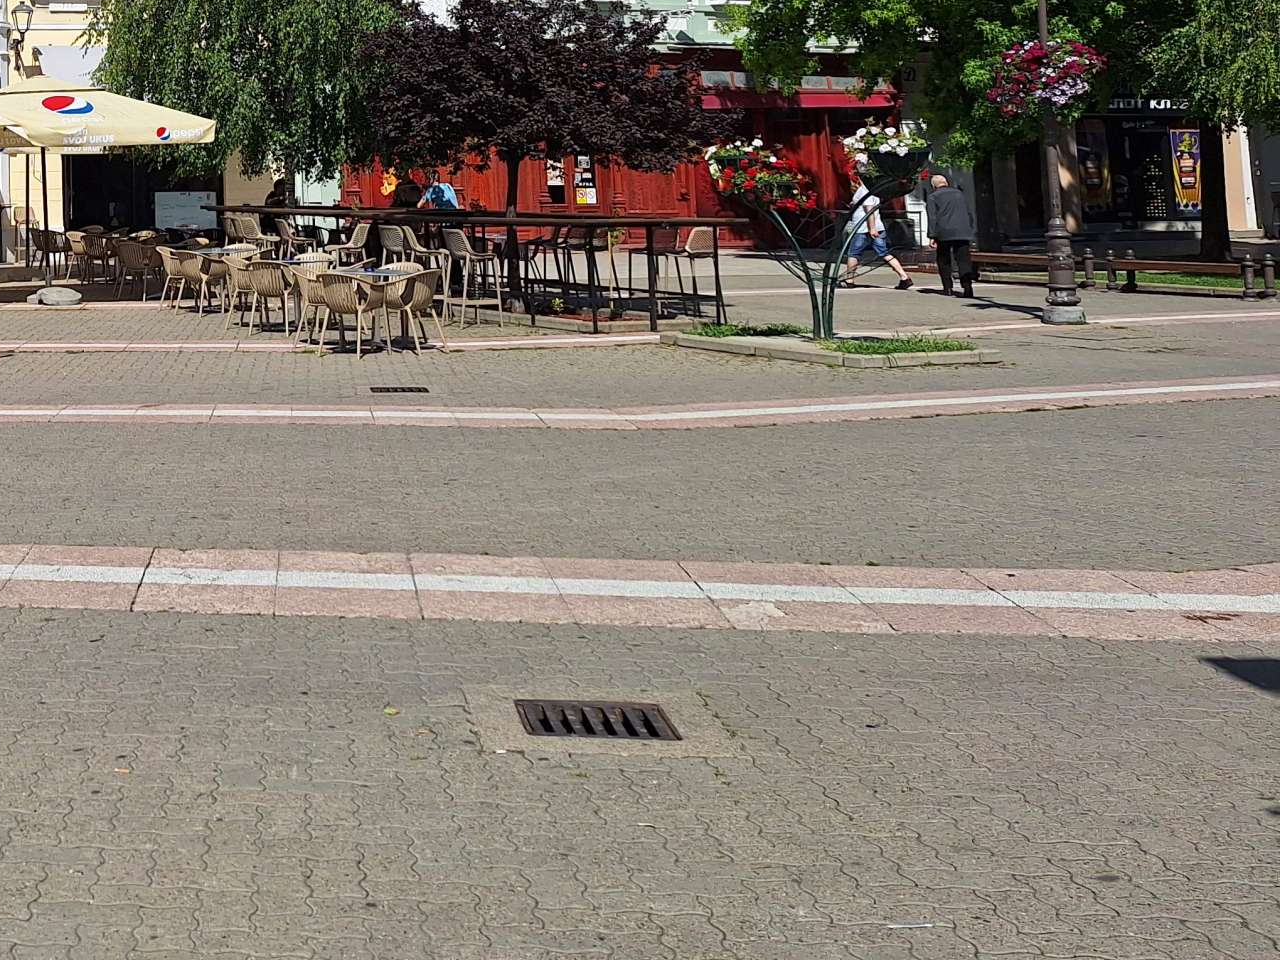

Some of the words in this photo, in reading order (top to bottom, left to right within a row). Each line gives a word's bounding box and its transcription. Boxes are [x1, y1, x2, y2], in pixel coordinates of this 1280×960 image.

[1108, 99, 1145, 109] ЛОТ
[174, 127, 204, 139] pepsi
[90, 135, 114, 144] UKUS
